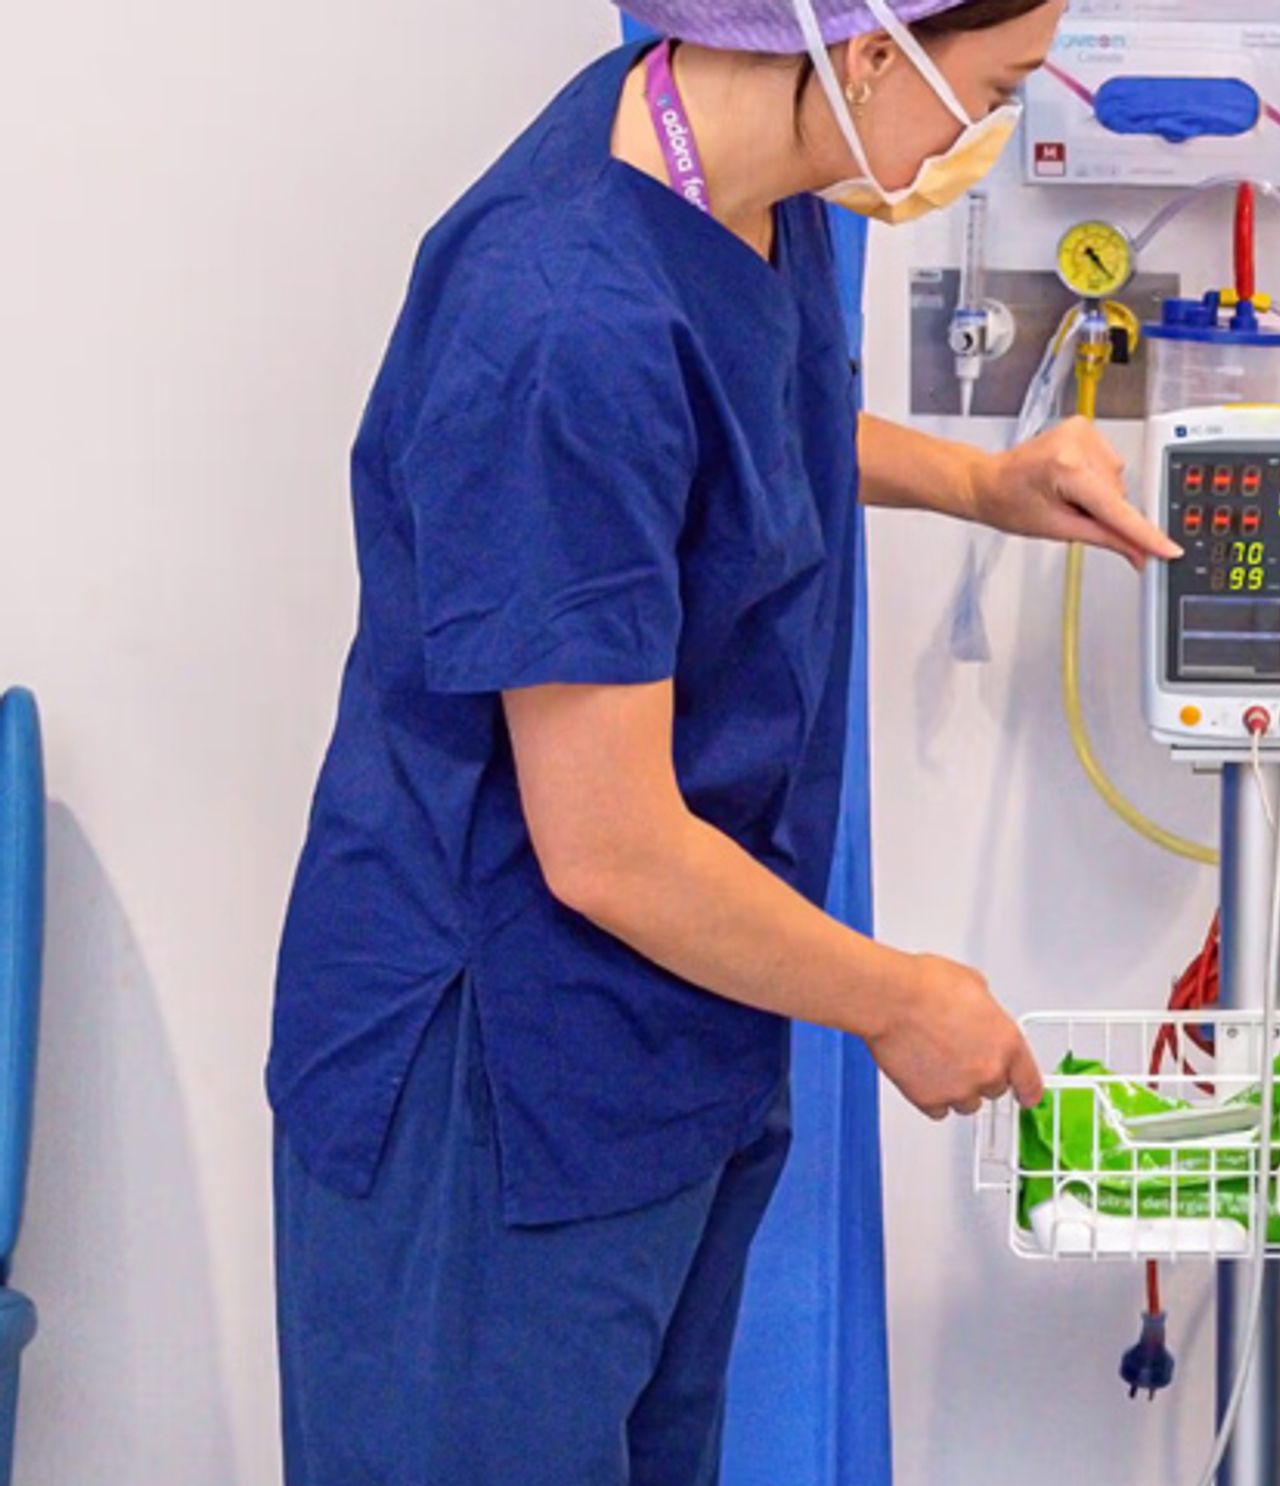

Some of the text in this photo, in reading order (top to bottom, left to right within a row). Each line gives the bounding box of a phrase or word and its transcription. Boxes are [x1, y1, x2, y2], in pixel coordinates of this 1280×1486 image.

[661, 109, 693, 172] adora
[1232, 541, 1265, 565] 70
[1229, 566, 1265, 590] 99
